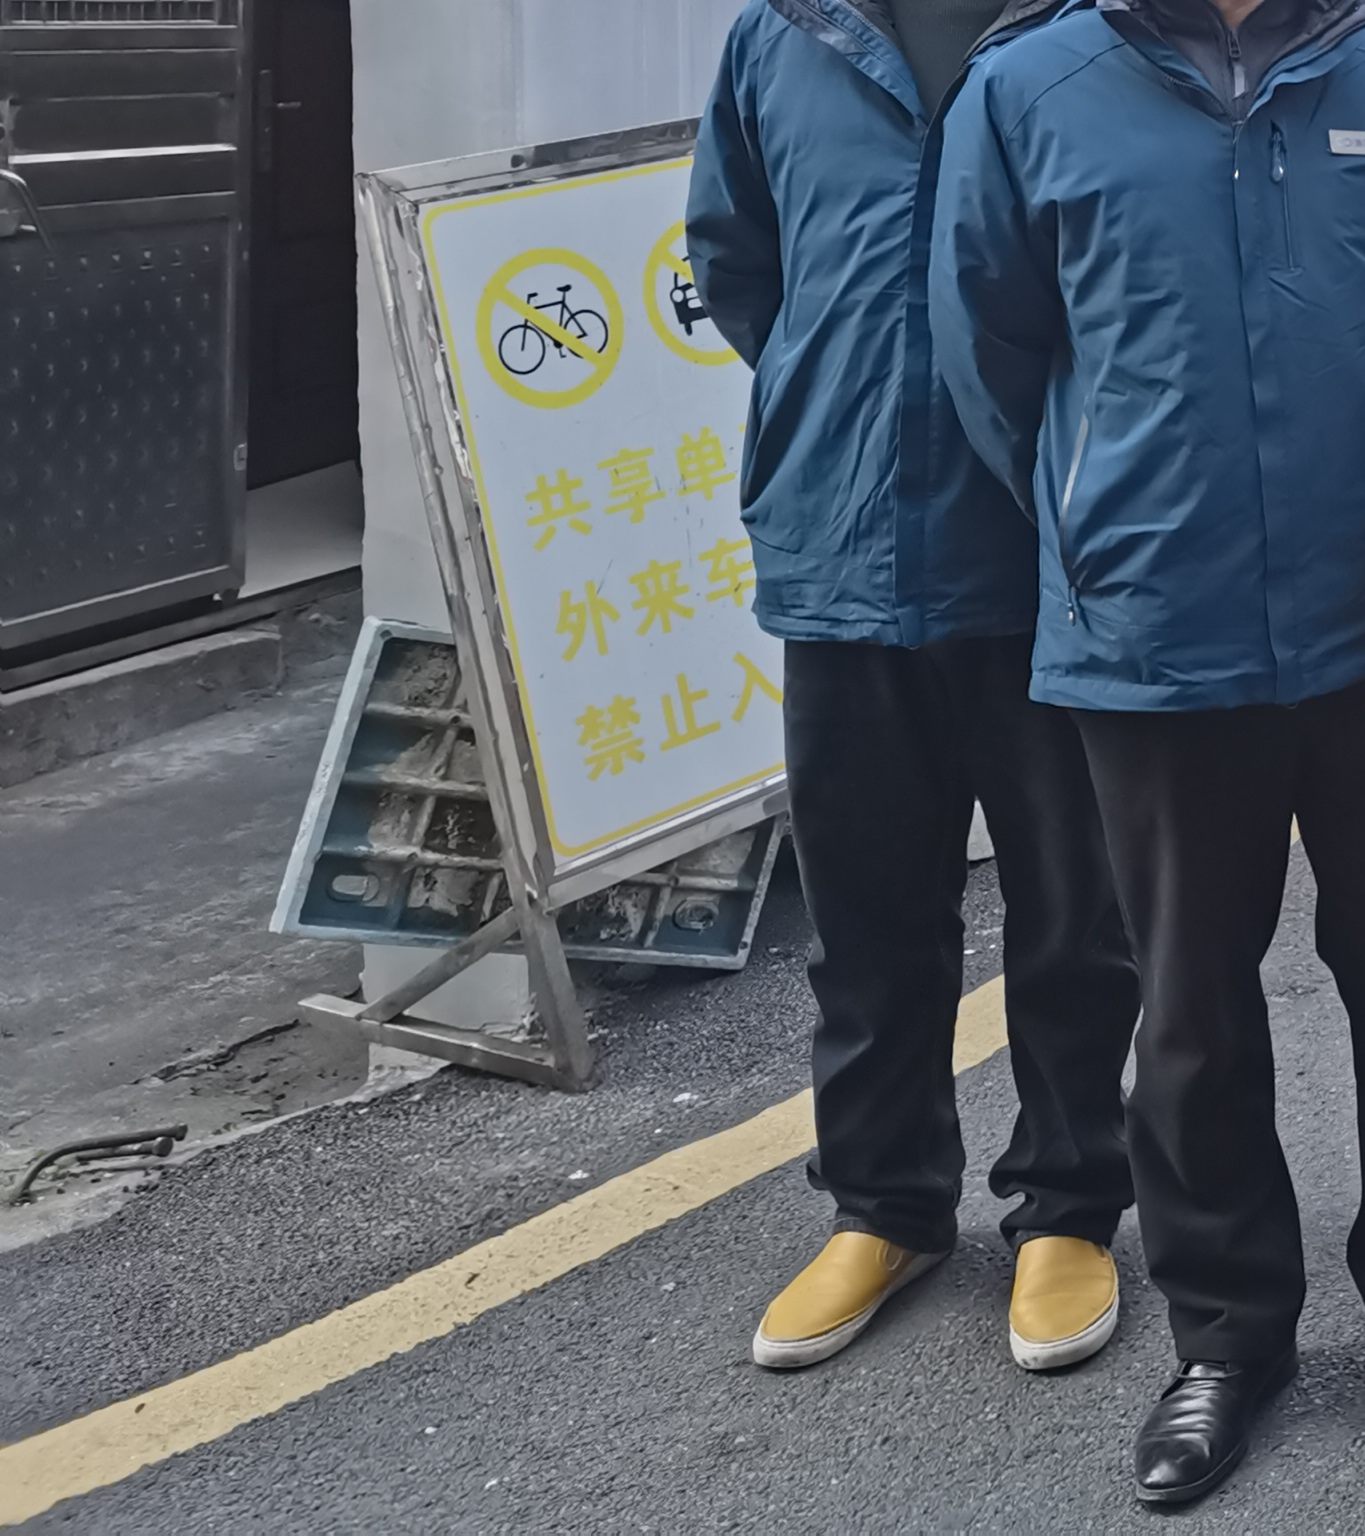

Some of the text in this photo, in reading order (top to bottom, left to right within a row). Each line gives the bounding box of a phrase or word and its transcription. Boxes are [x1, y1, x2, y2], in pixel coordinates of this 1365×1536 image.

[525, 424, 746, 552] 共享单
[575, 651, 785, 782] 禁止入
